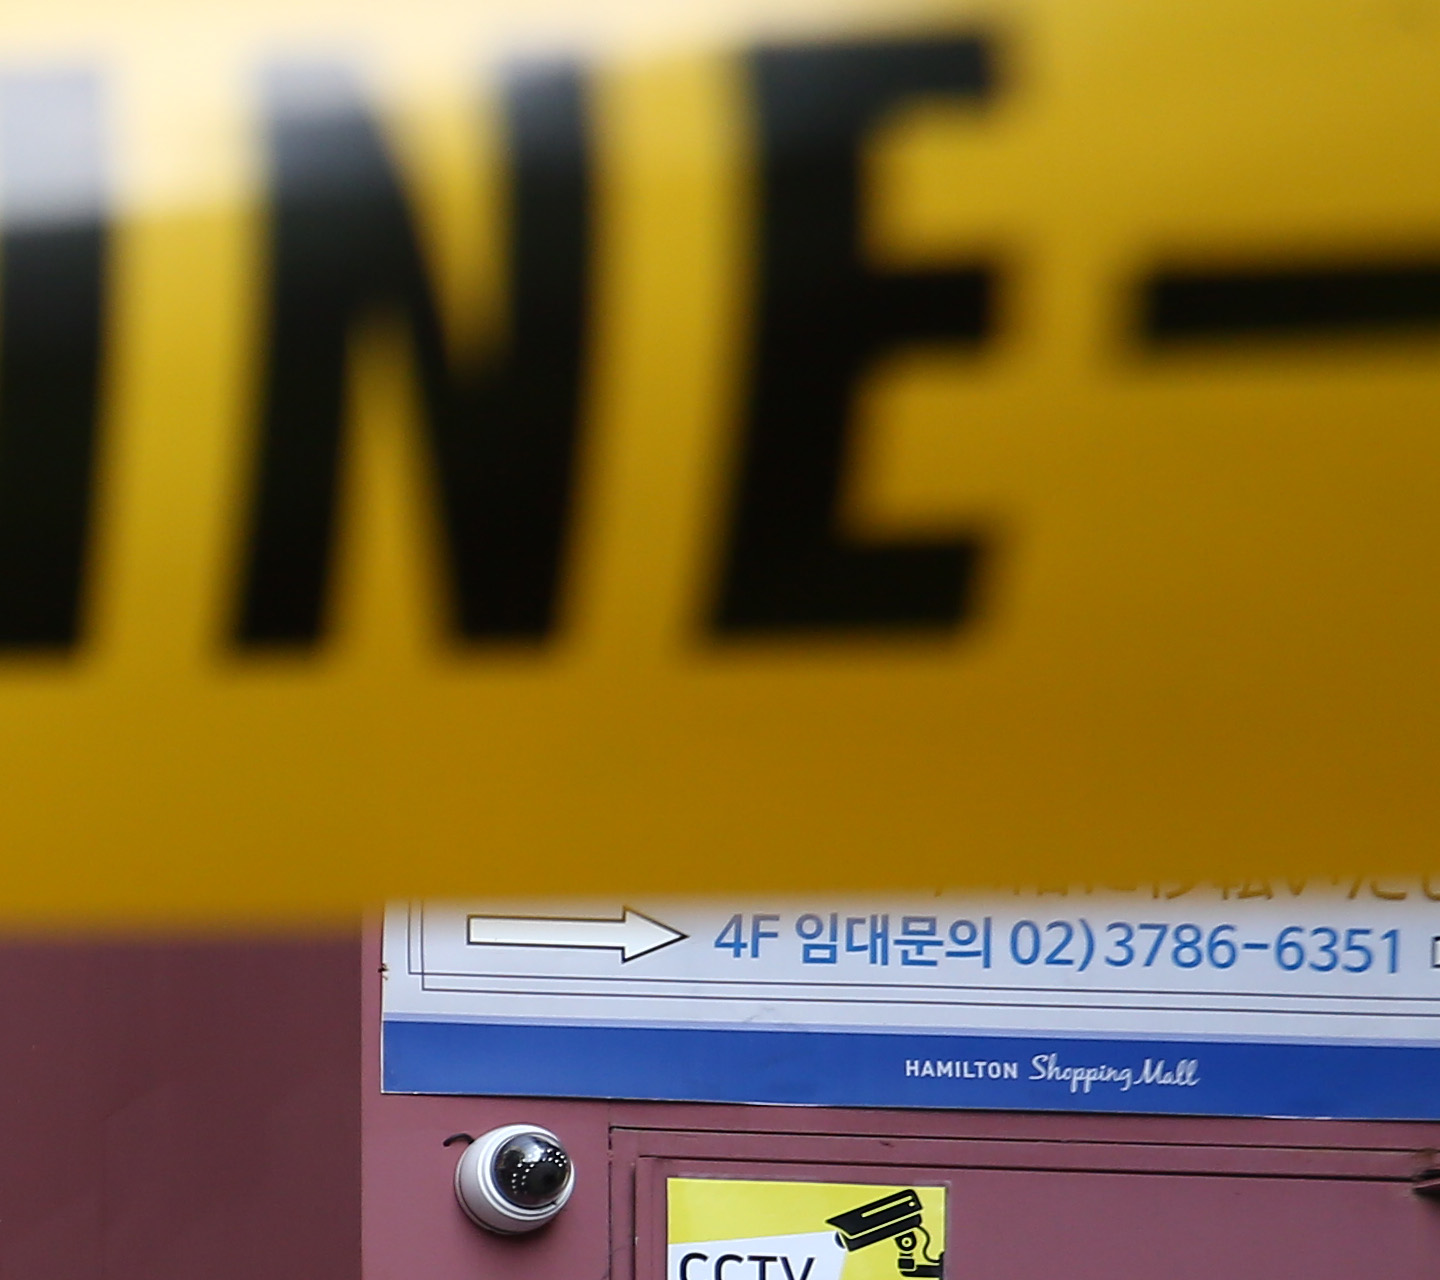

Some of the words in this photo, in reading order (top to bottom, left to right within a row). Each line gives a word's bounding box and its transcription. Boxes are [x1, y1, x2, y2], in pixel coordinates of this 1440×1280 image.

[713, 914, 779, 958] 4F
[796, 914, 993, 970] 임대문의
[1009, 917, 1400, 975] 02)3786-6351
[905, 1058, 1018, 1081] HAMILTON
[1028, 1053, 1133, 1093] Shopping
[1136, 1057, 1200, 1089] Mall
